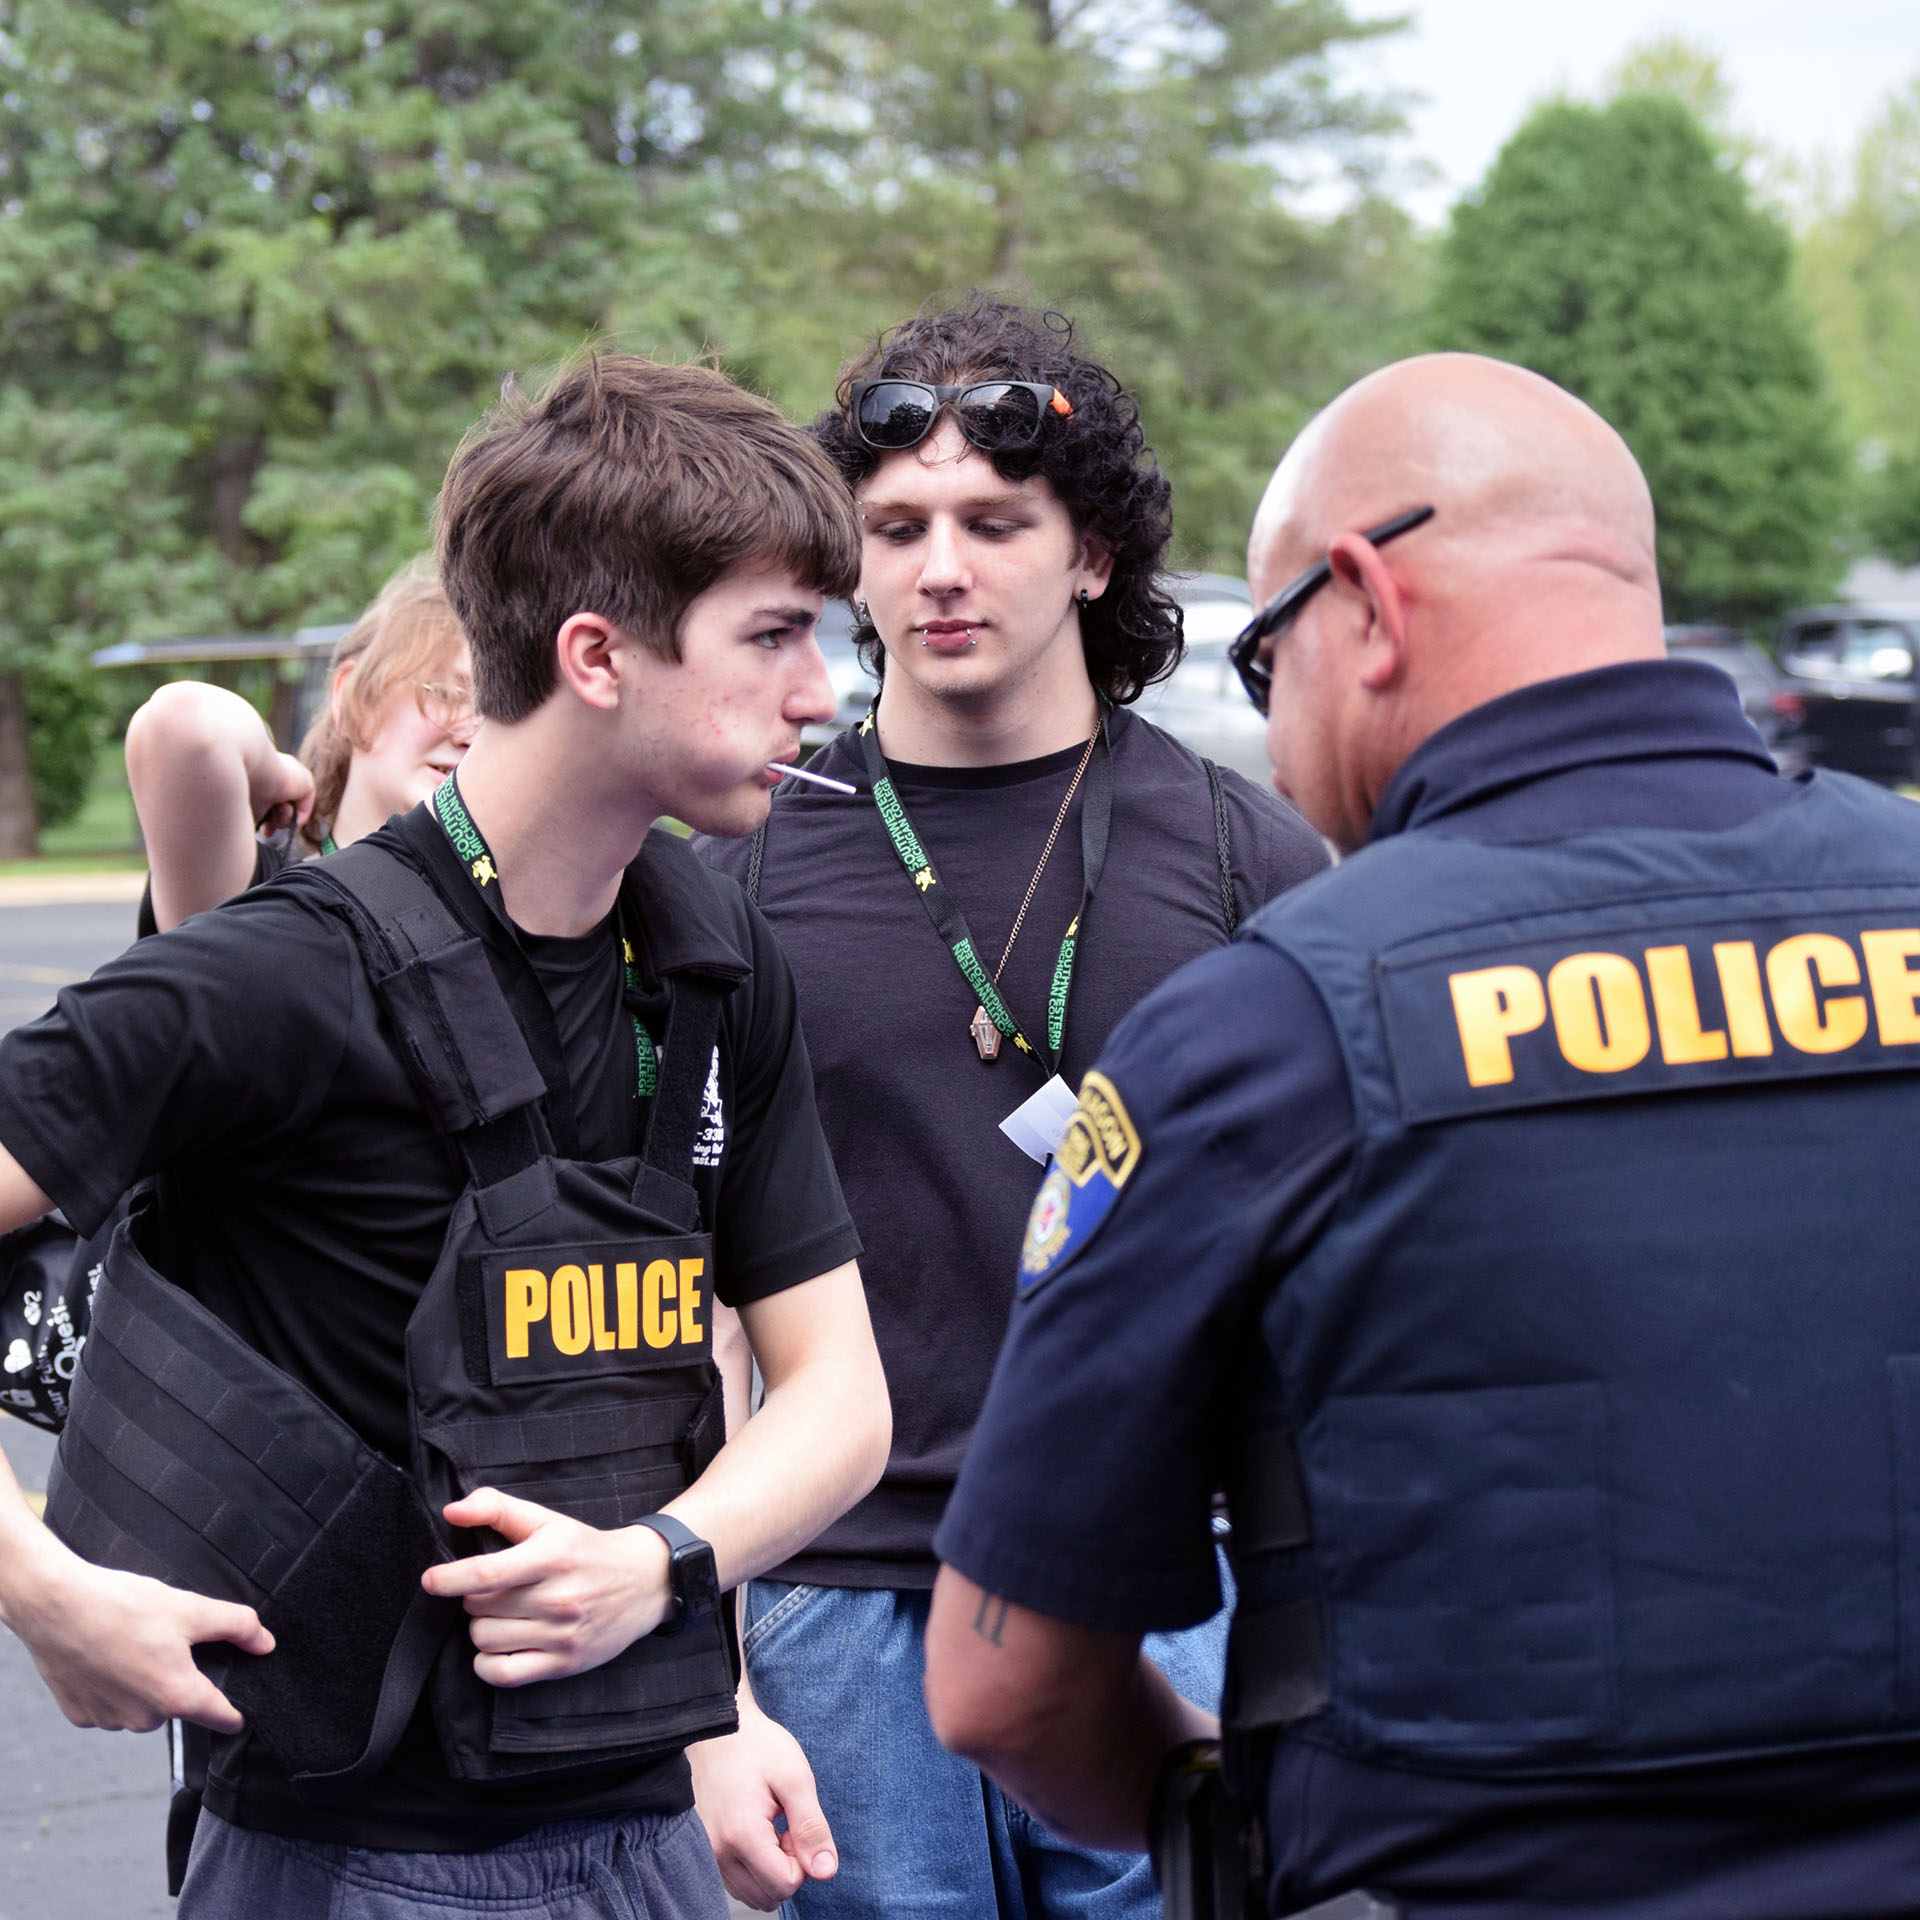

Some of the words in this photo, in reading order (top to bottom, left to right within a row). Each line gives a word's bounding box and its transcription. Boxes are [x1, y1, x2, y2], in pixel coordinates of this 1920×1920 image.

[449, 795, 485, 857] MICHIGAN
[873, 780, 920, 872] SOUTHWESTERN
[881, 777, 905, 818] COLLEGE
[900, 818, 929, 867] MICHIGAN
[952, 942, 1011, 1038] SOUTHWESTERN
[959, 937, 986, 983] COLLEGE
[985, 982, 1017, 1034] MICHIGAN
[1050, 939, 1075, 1050] SOUTHWESTERN
[1449, 929, 1920, 1087] POLICE
[637, 1037, 648, 1097] COLLEGE
[505, 1258, 704, 1359] POLICE
